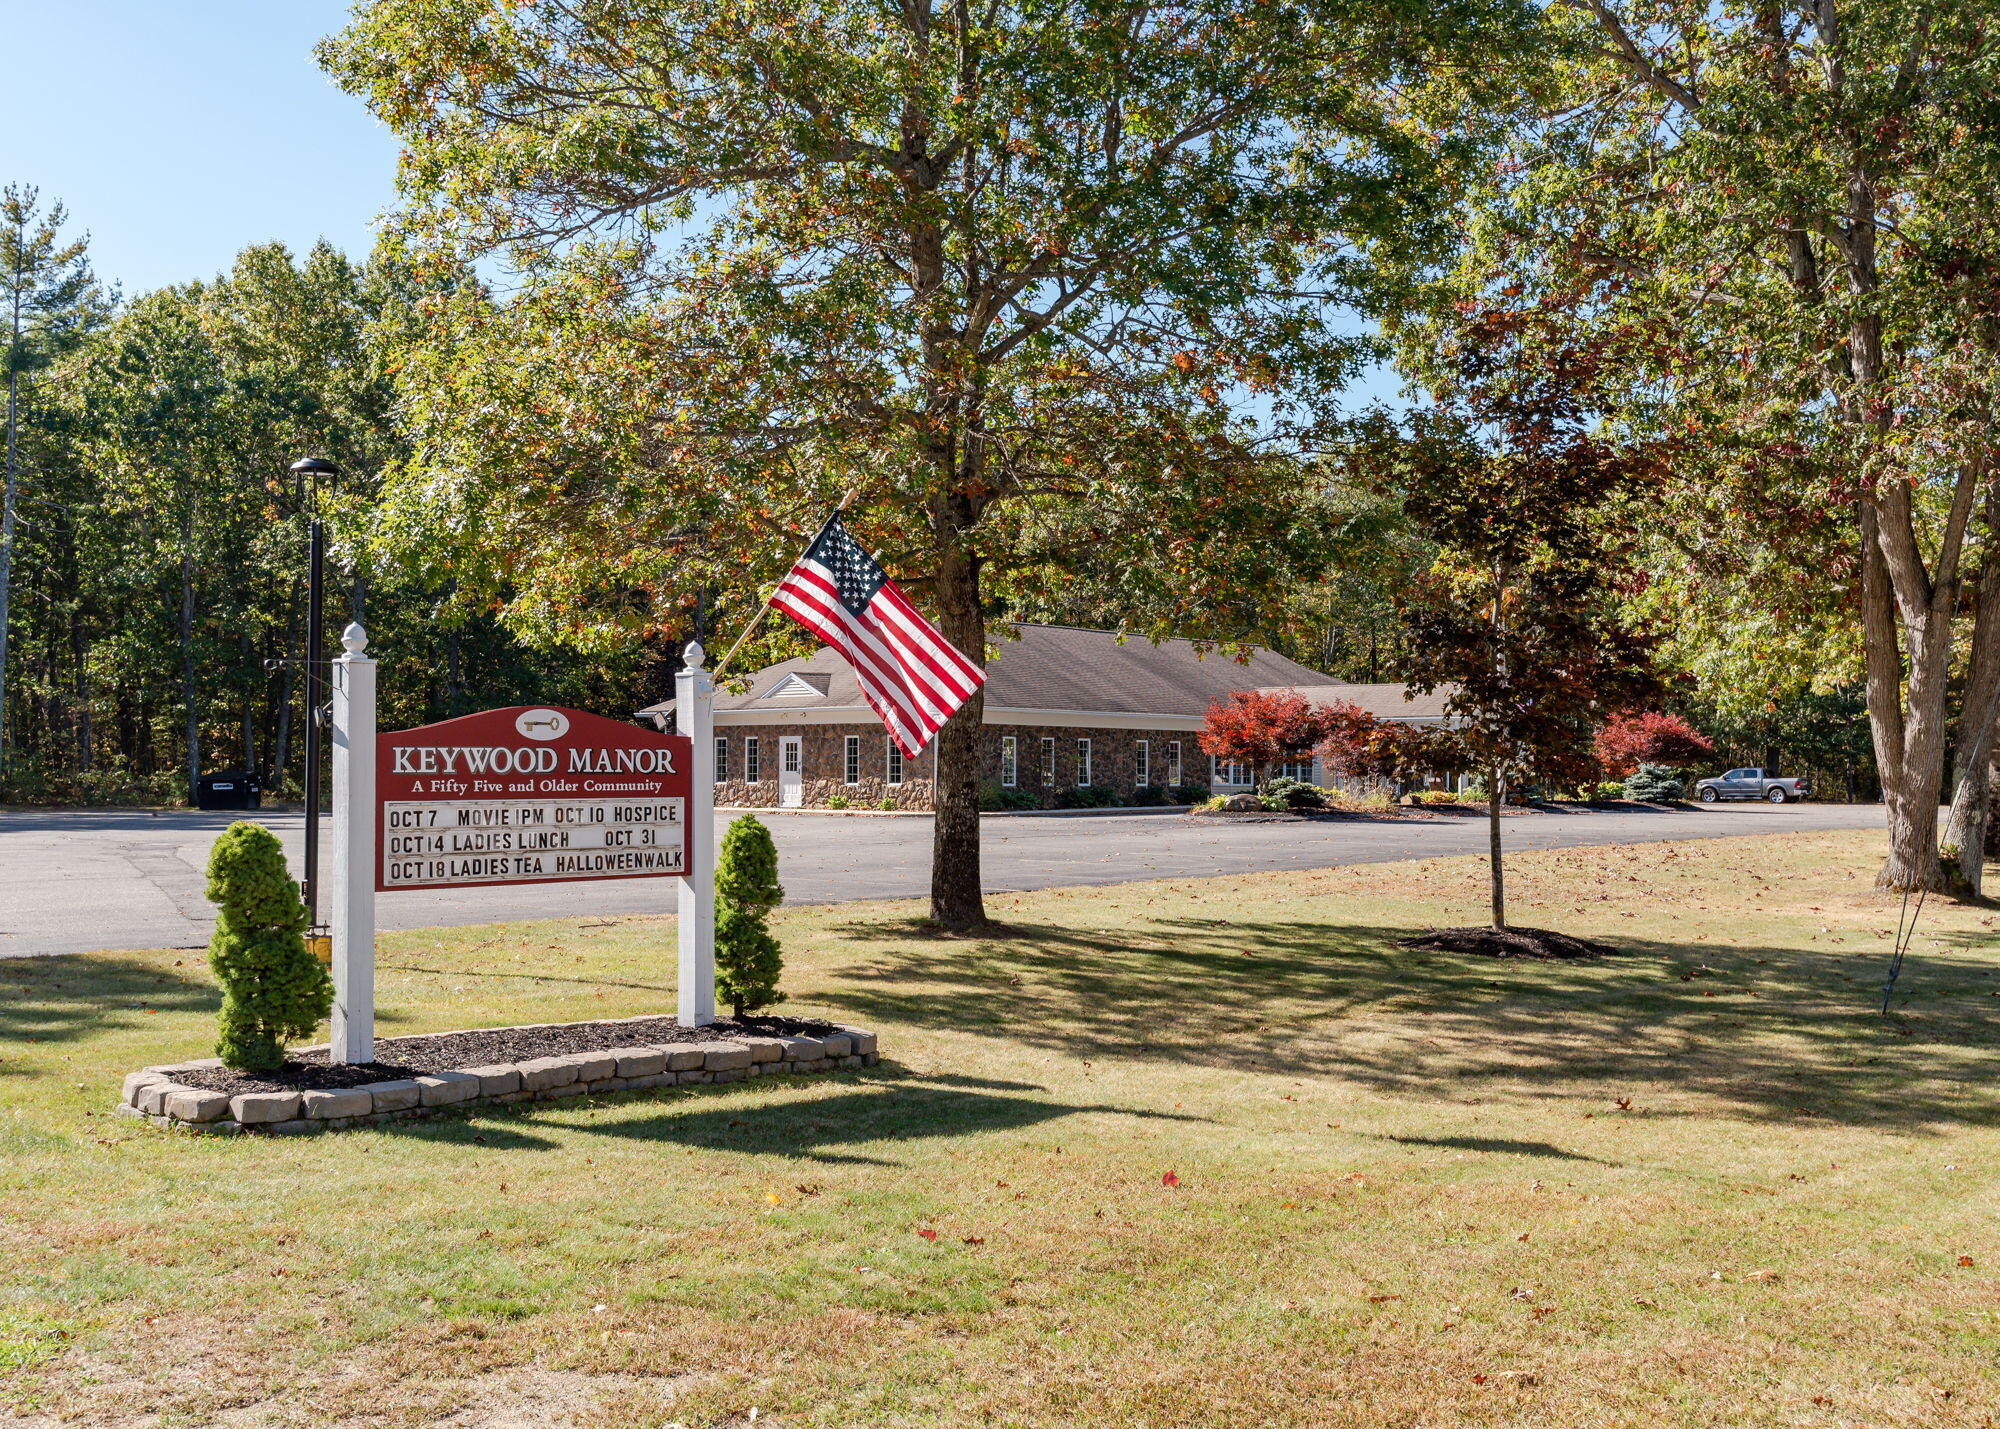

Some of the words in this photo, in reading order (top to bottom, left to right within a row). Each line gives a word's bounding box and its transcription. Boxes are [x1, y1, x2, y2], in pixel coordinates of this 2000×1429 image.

[392, 746, 558, 775] KEYWOOD
[567, 747, 677, 775] MANOR
[411, 780, 424, 793] A
[430, 779, 468, 796] Fifty
[473, 780, 503, 792] Five
[508, 779, 535, 792] and
[540, 779, 579, 792] Older
[583, 779, 663, 794] Community
[390, 810, 423, 828] OCT
[428, 810, 438, 827] 7
[457, 809, 510, 827] MOVIE
[555, 807, 584, 823] OCT
[589, 807, 604, 823] 10
[614, 805, 677, 822] HOSPICE
[391, 836, 424, 854] OCT
[427, 835, 444, 852] 14
[453, 832, 512, 852] LADIES
[518, 831, 569, 850] LUNCH
[605, 830, 633, 847] OCT
[641, 829, 655, 845] 31
[391, 861, 424, 880] OCT
[429, 861, 445, 878] 18
[450, 857, 509, 877] LADIES
[514, 857, 543, 874] TEA
[556, 851, 682, 873] HALLOWEENWALK
